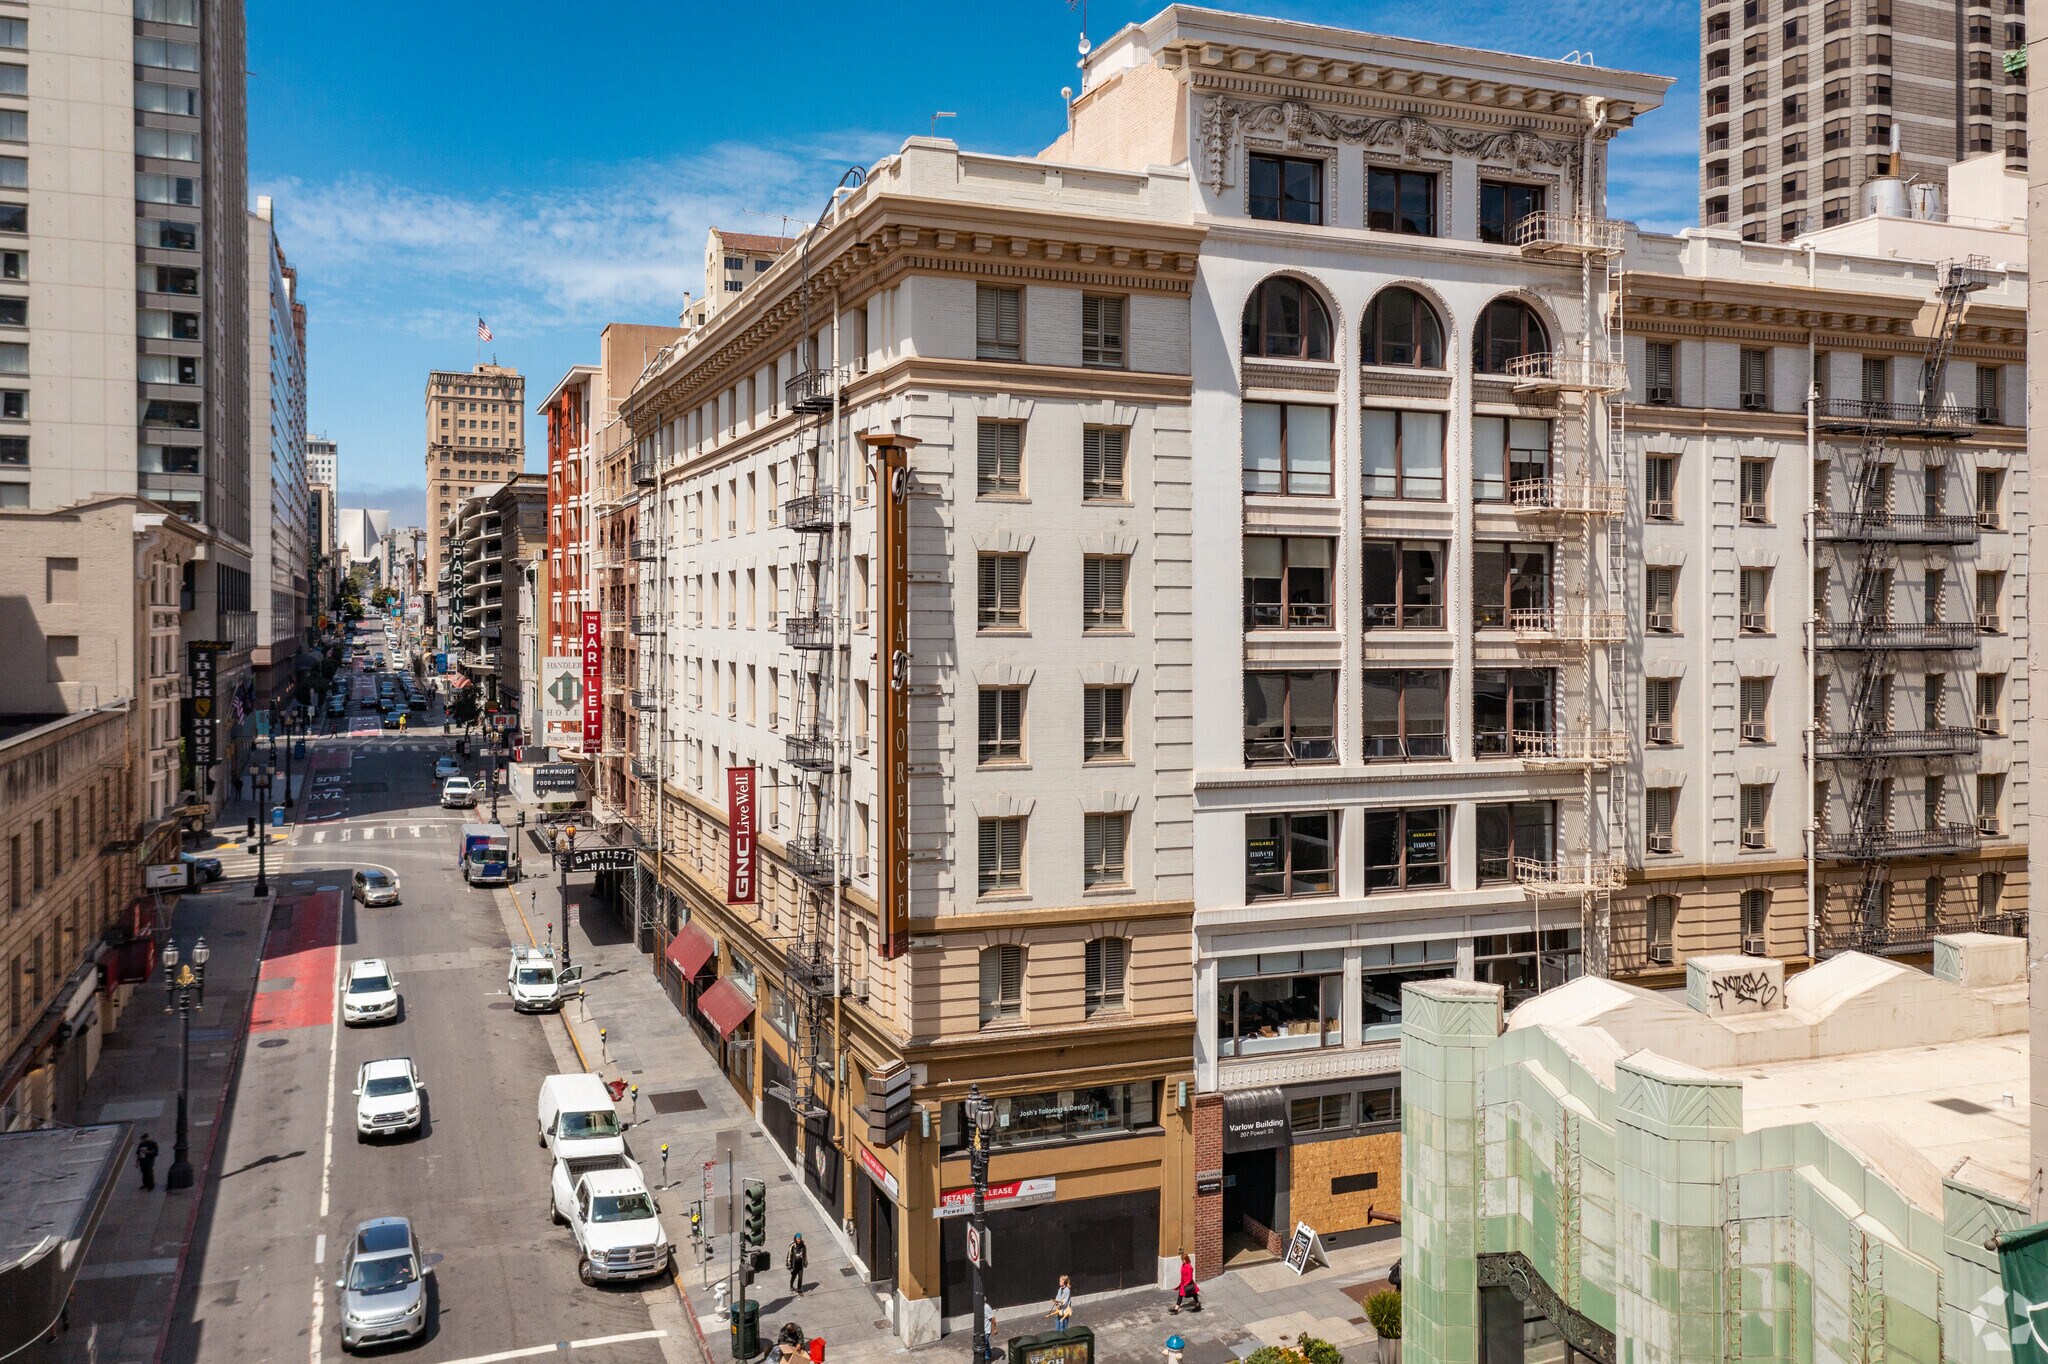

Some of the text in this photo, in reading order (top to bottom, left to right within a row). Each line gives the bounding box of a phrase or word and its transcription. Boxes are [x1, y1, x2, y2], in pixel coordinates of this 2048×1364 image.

[453, 548, 463, 637] PARKING
[586, 623, 599, 736] BARTLETT
[193, 652, 212, 762] IRISH HOUSE
[1413, 841, 1436, 849] maven
[575, 850, 634, 864] BARTLETT
[1250, 850, 1274, 858] maven
[590, 863, 618, 871] HALL
[735, 838, 750, 899] GNC
[1020, 1109, 1037, 1118] Josh's
[1038, 1106, 1063, 1115] Tailoring
[1069, 1103, 1090, 1112] Design
[1229, 1119, 1284, 1132] Varlow Building
[1250, 1129, 1267, 1137] Powell
[988, 1187, 1013, 1196] LEASE
[942, 1207, 965, 1215] Powell
